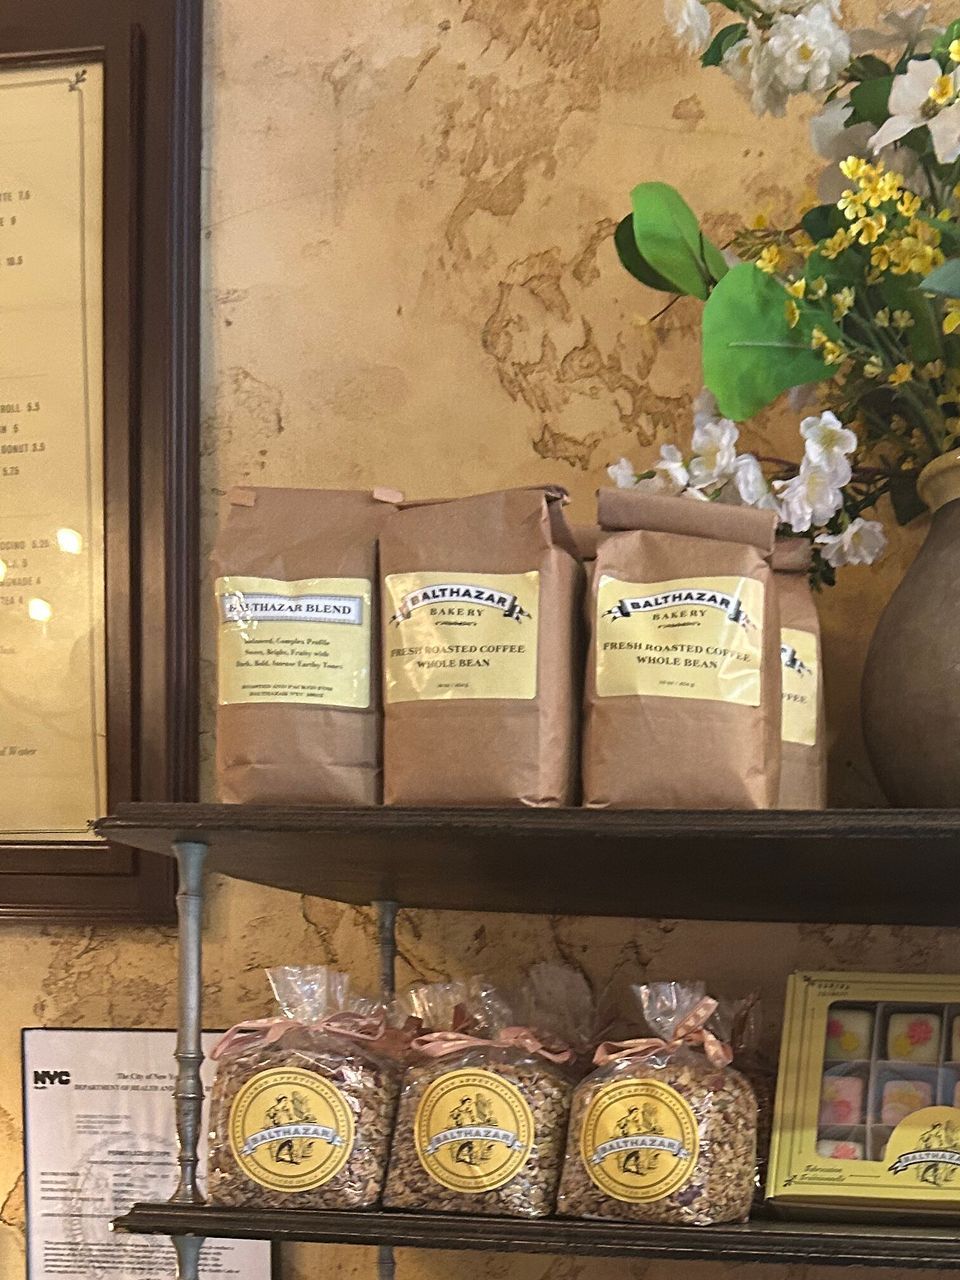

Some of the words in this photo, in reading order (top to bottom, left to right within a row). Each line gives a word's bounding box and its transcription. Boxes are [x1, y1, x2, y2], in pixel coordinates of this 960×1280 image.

[411, 588, 507, 606] BALTHAZAR
[630, 591, 731, 610] BALTHAZAR
[306, 604, 351, 615] BLEND
[429, 608, 485, 617] BAKERY
[652, 609, 708, 621] BAKERY
[391, 646, 422, 657] FRESH
[425, 645, 477, 654] ROASTED
[479, 644, 526, 654] COFFEE
[603, 642, 642, 651] FRESH
[645, 643, 703, 654] ROASTED
[705, 647, 752, 663] COFFEE
[417, 660, 457, 668] WHOLE
[459, 659, 490, 667] BEAN
[636, 656, 680, 666] WHOLE
[684, 658, 718, 669] BEAN
[33, 1071, 70, 1085] NYC
[251, 1127, 330, 1142] BALTHAZAR
[434, 1130, 510, 1146] BALTHAZAR
[601, 1139, 676, 1155] BALTHAZAR
